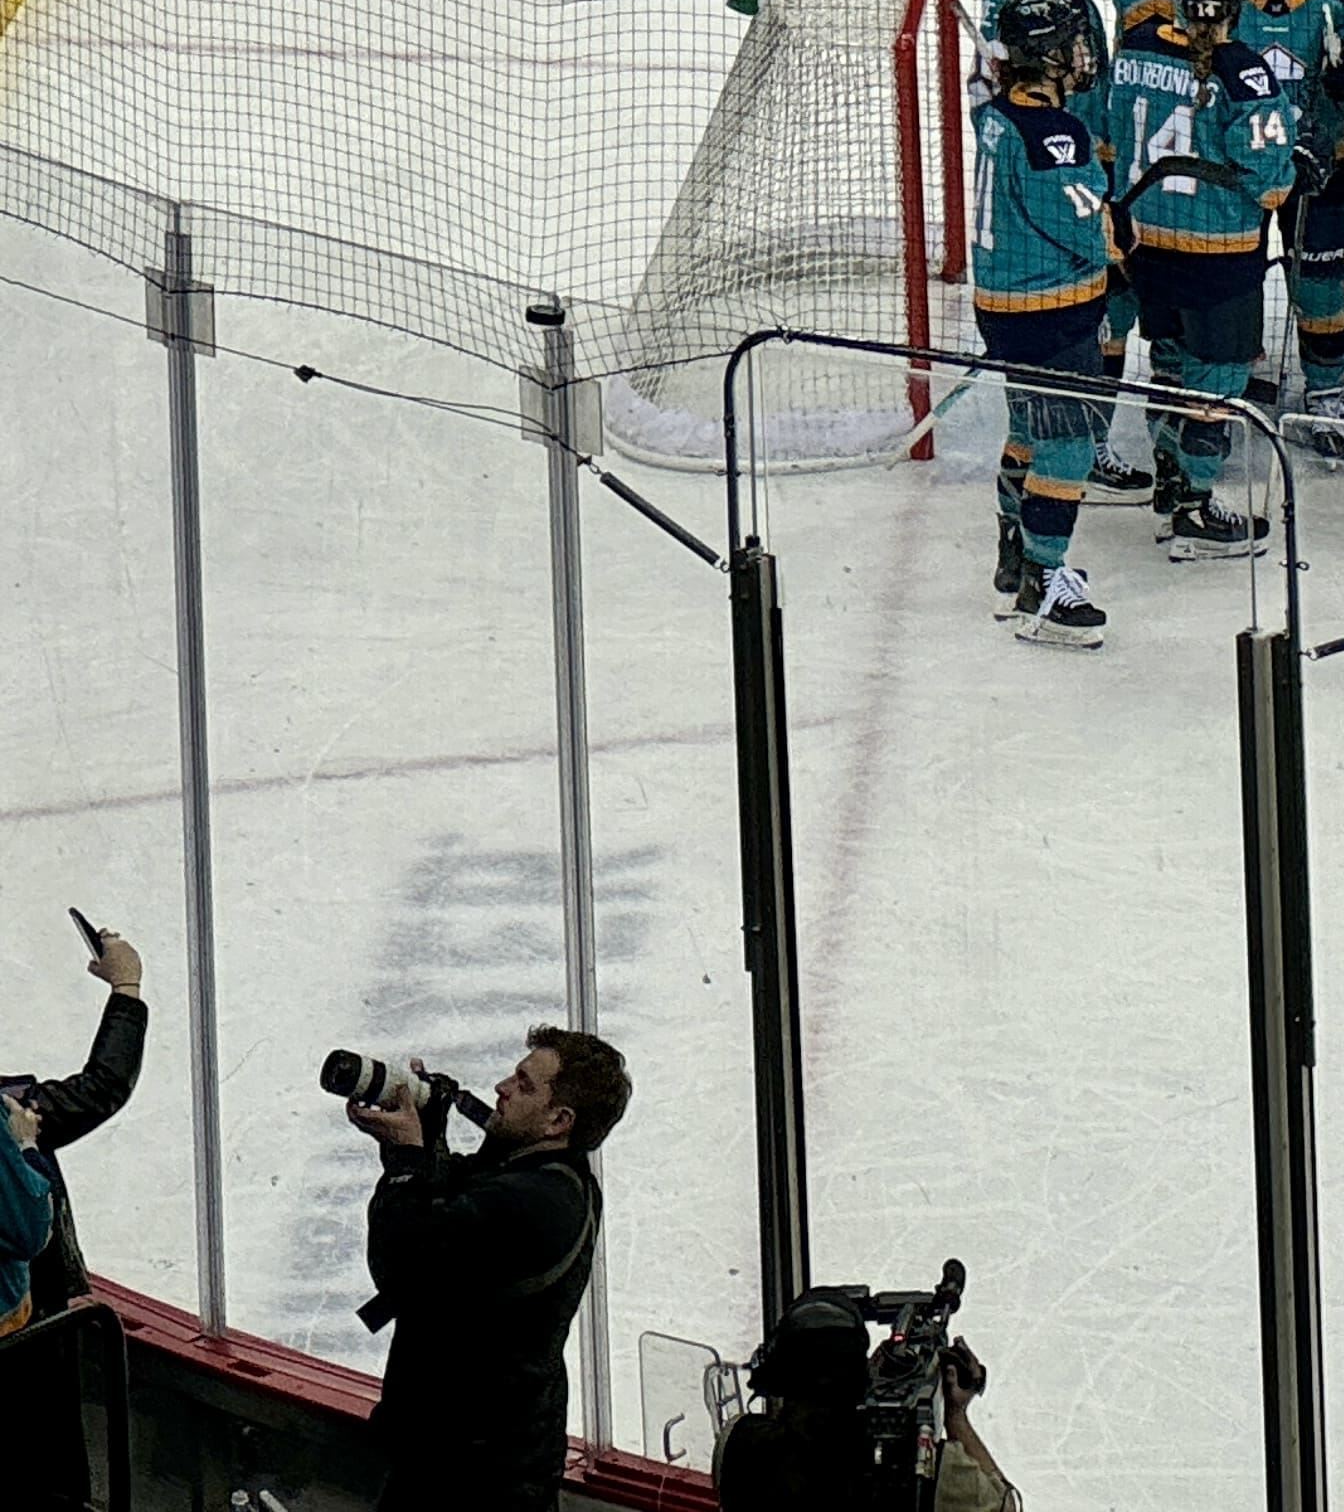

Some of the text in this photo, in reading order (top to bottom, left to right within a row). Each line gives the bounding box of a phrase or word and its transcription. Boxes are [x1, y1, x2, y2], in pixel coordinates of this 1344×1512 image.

[1114, 55, 1220, 110] BOURBONNS
[1132, 96, 1198, 196] 14
[1249, 110, 1288, 151] 14
[1301, 247, 1344, 263] AUER
